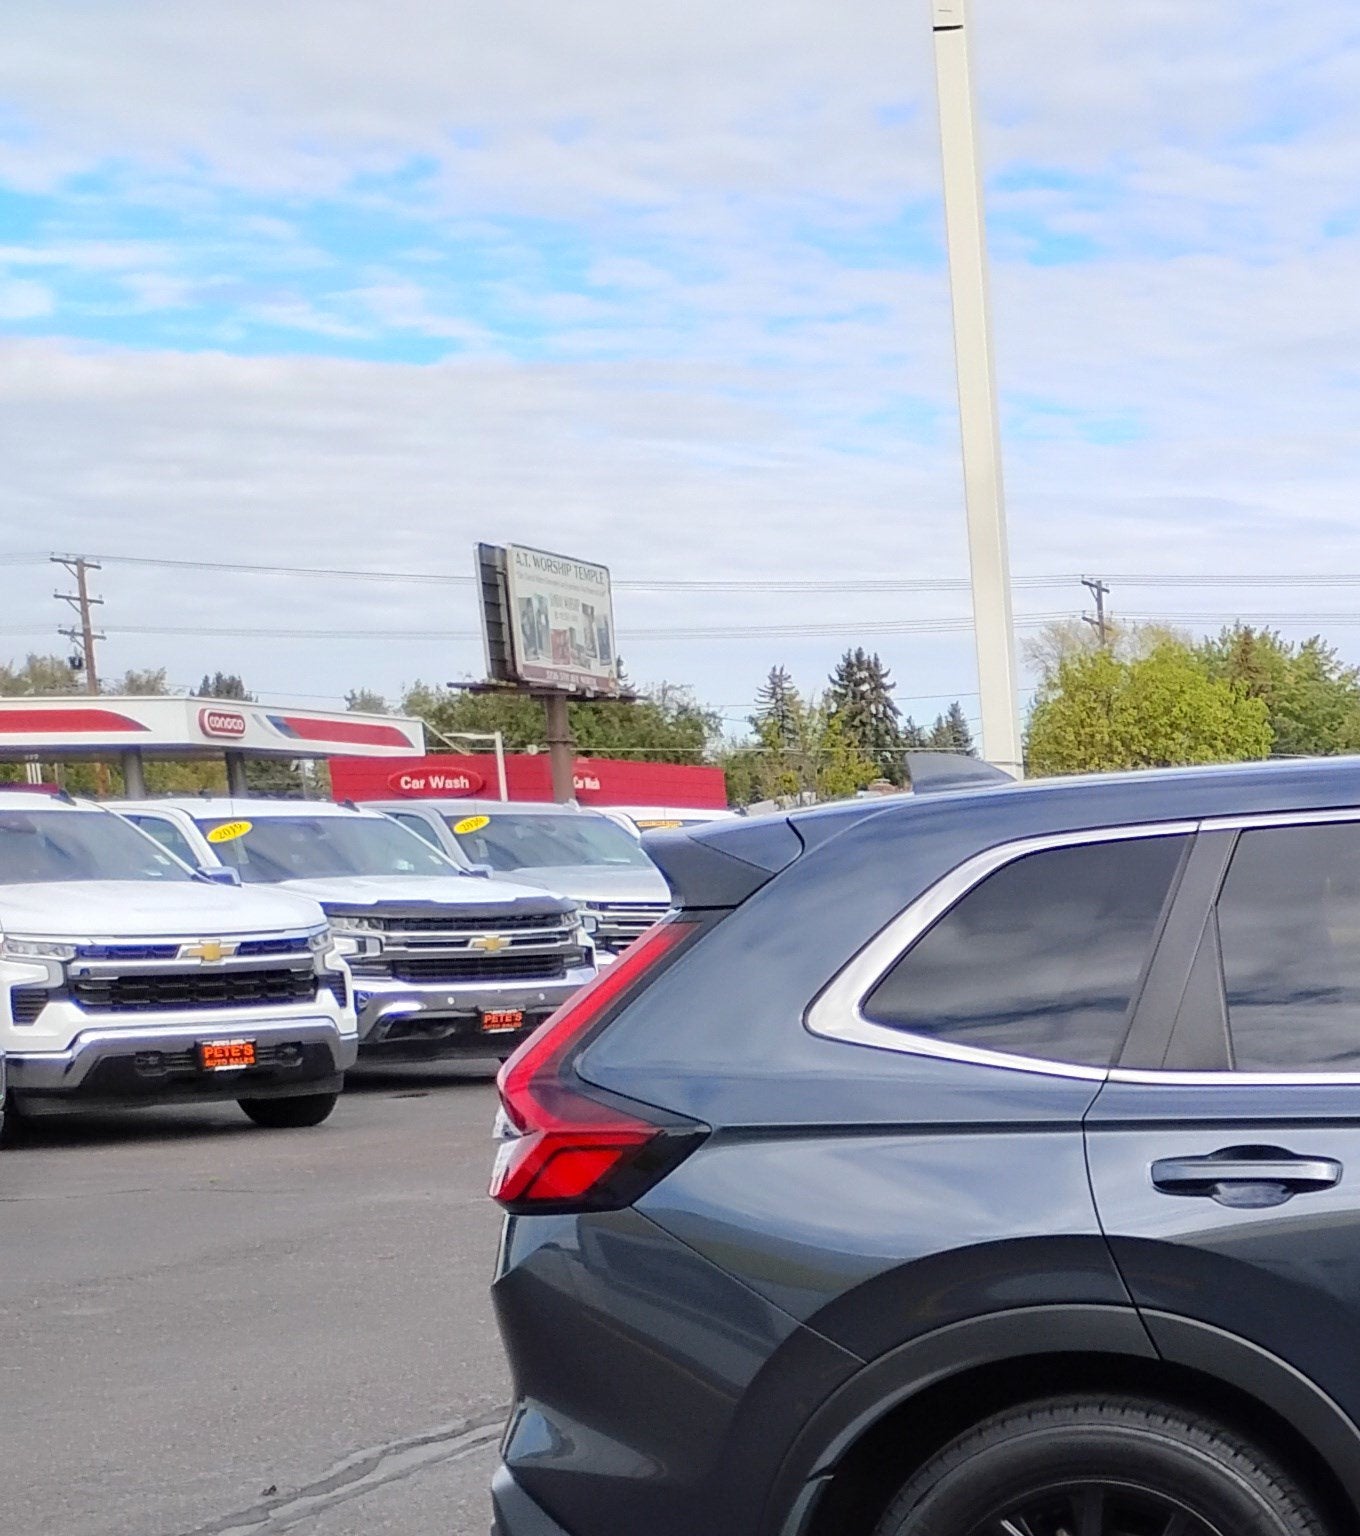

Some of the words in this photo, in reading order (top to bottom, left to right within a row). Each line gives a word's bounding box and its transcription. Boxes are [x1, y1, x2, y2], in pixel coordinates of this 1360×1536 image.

[532, 555, 572, 575] WORSHIP
[574, 565, 605, 585] TEMPLE
[400, 775, 425, 790] Car
[429, 774, 470, 790] Wash
[204, 1044, 254, 1058] PETE'S
